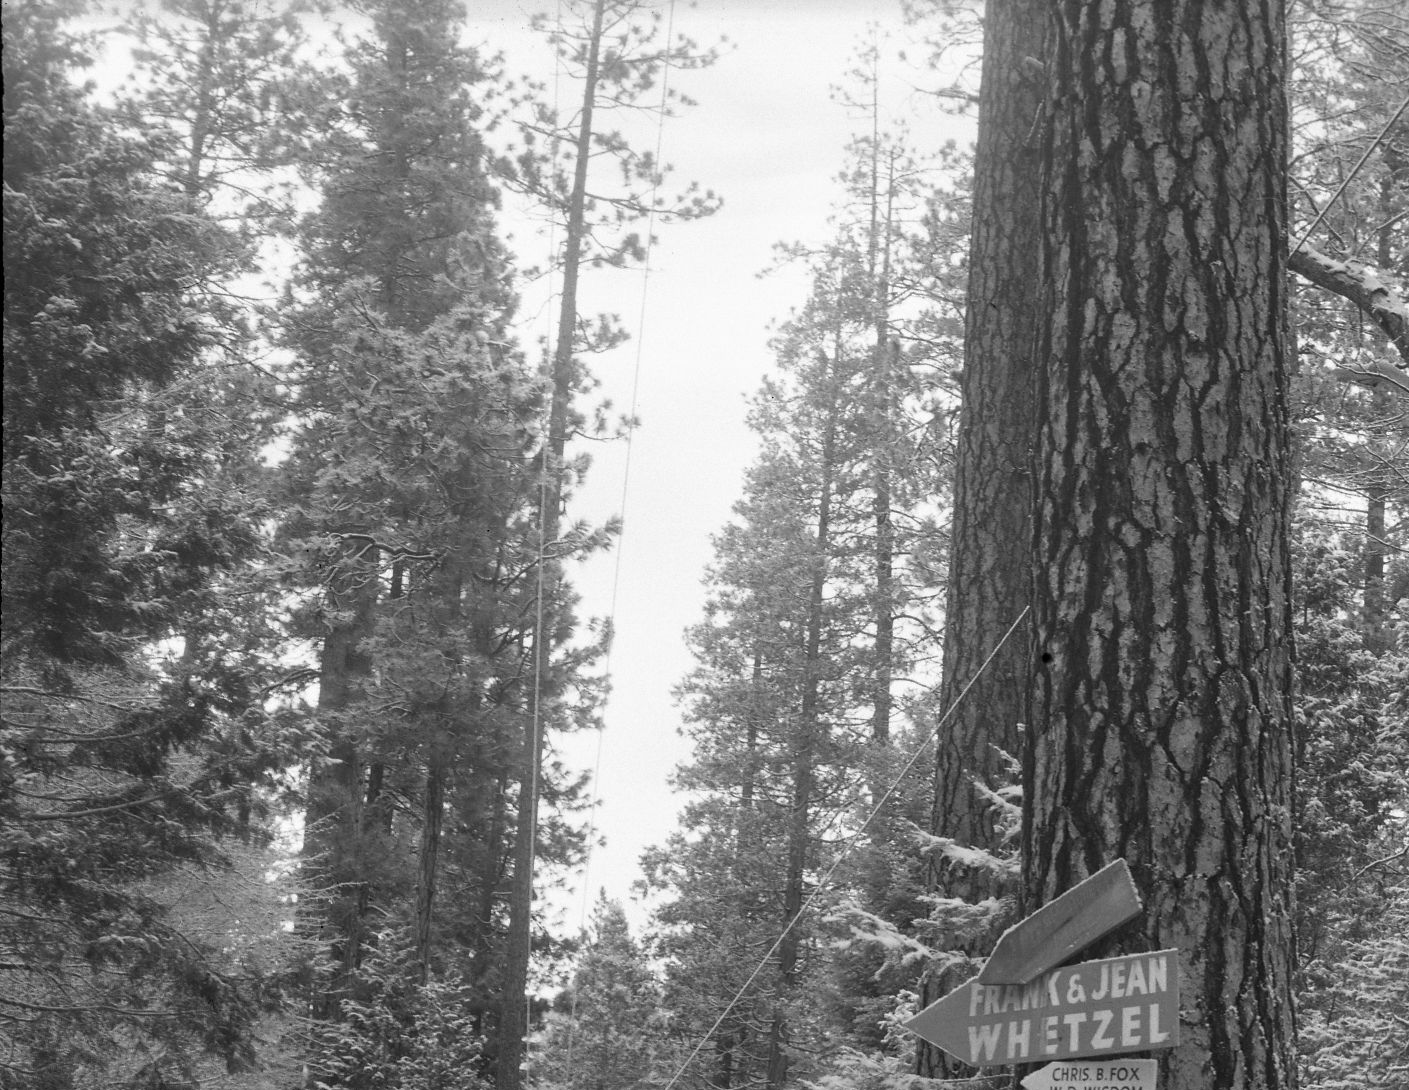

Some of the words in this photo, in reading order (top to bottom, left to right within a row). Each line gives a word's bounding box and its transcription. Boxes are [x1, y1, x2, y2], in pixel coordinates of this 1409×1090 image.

[1066, 973, 1087, 1004] &
[1091, 956, 1167, 1001] JEAN
[968, 1003, 1170, 1063] WHETZEL
[1110, 1067, 1140, 1081] FOX
